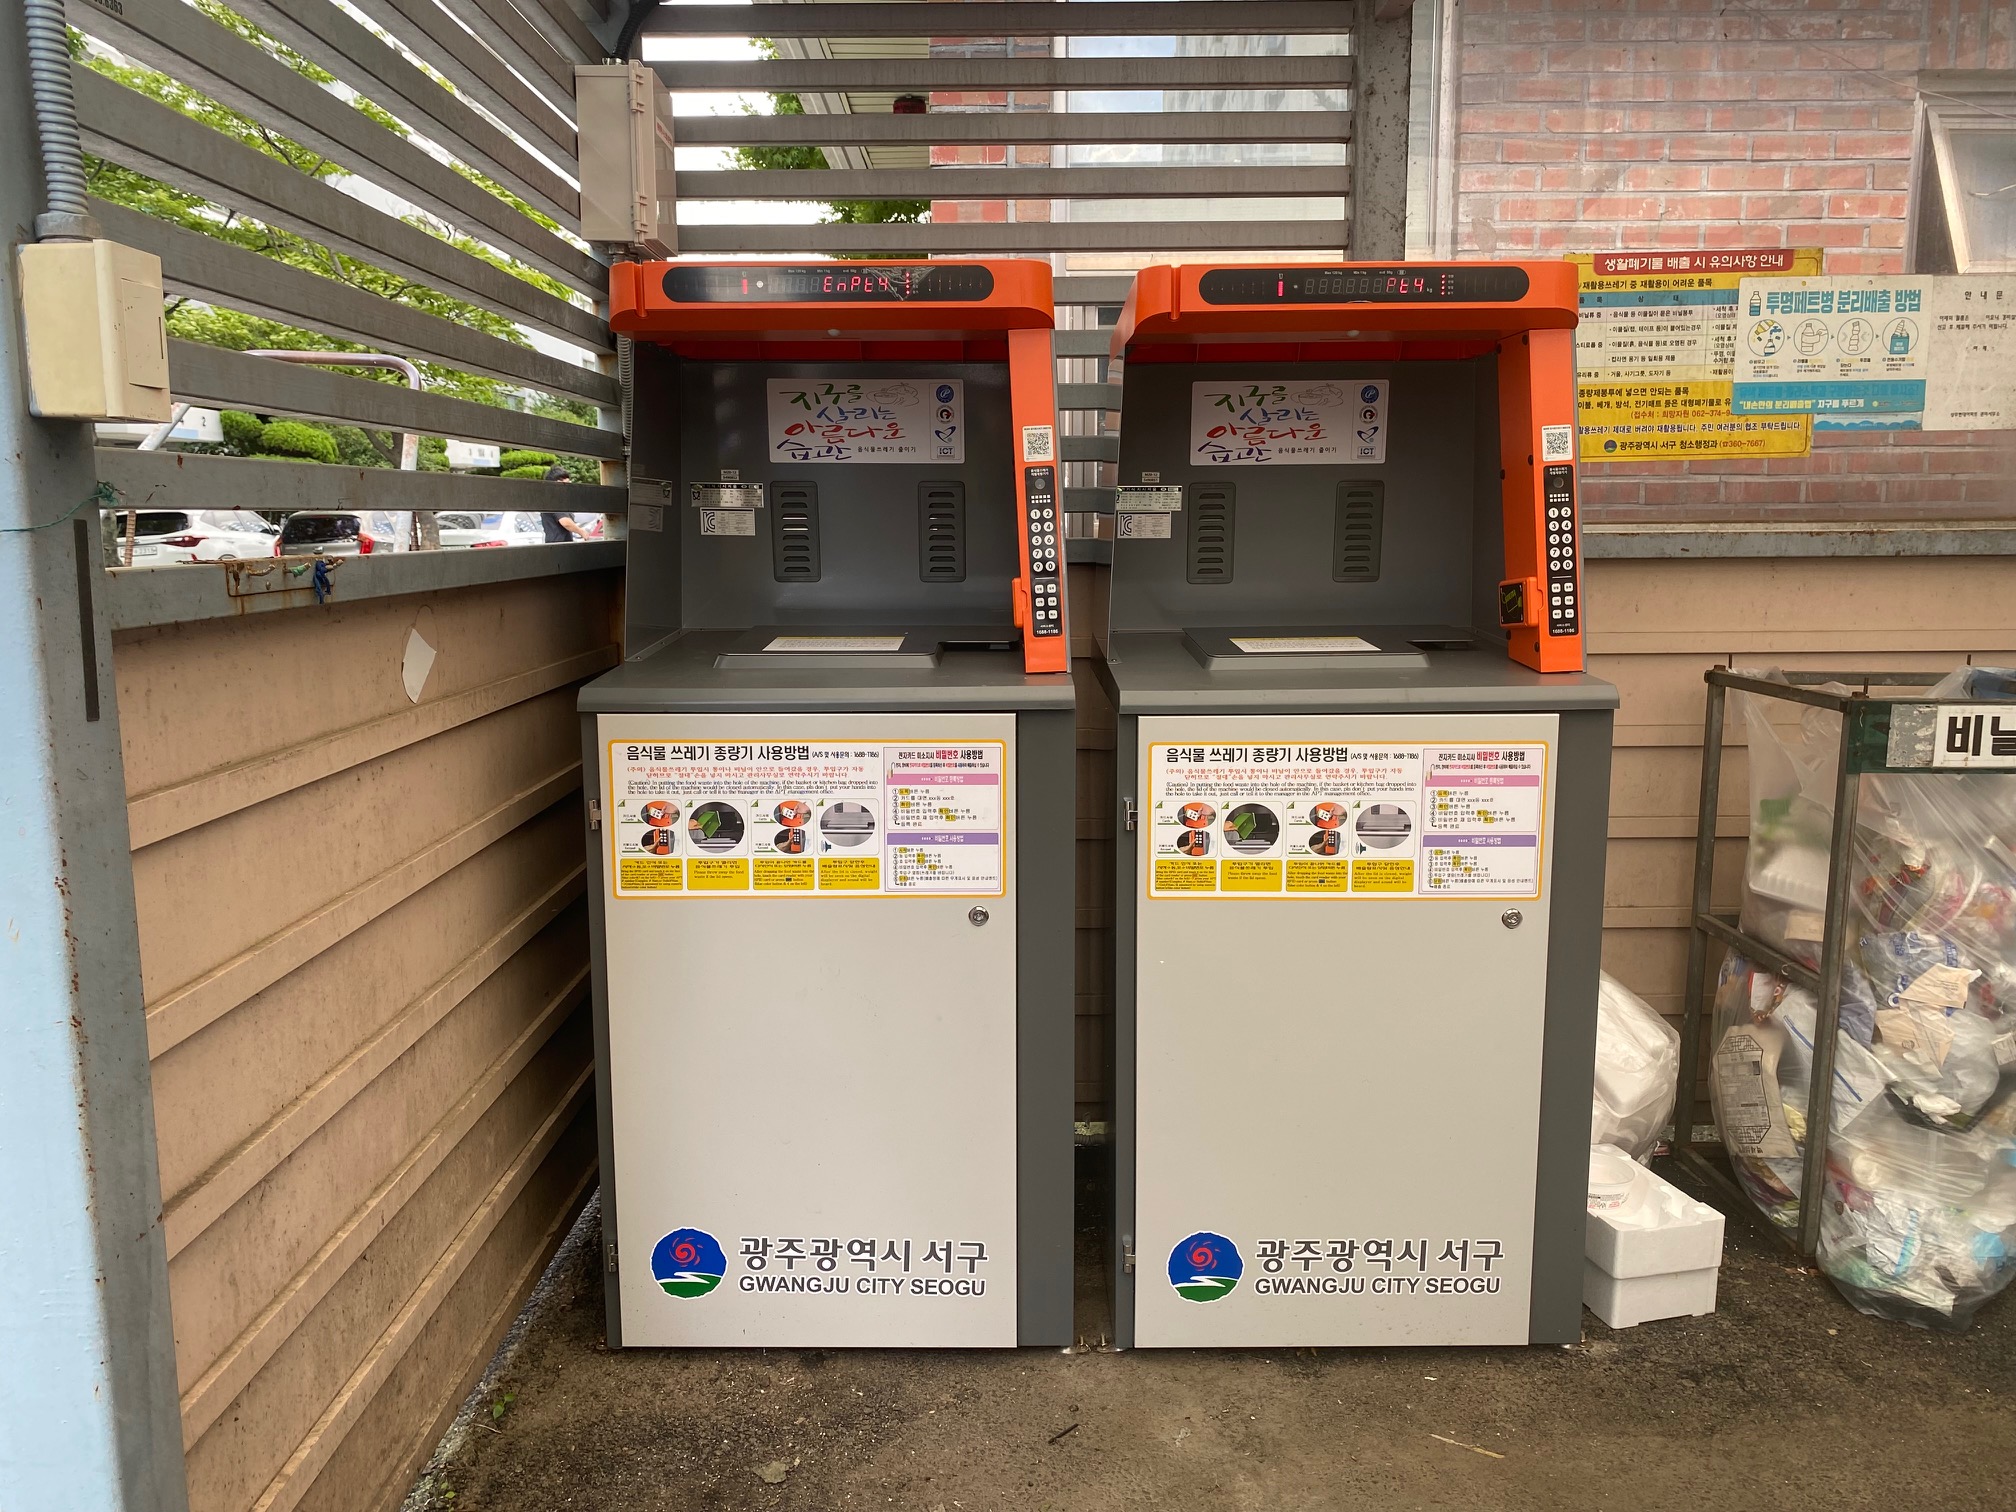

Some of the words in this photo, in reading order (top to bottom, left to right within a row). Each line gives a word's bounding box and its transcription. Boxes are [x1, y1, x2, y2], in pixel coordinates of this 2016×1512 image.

[1605, 257, 1663, 271] 생활폐기물
[1667, 257, 1690, 270] 배출
[1694, 256, 1706, 268] 시
[1709, 255, 1758, 268] 유의사항
[1760, 254, 1783, 267] 안내
[1583, 281, 1627, 289] 재활용쓰레기
[1630, 280, 1637, 288] 중
[1640, 279, 1669, 288] 재활용이
[1673, 279, 1694, 288] 어려운
[1698, 278, 1712, 287] 품목
[1766, 290, 1834, 314] 투명페트병
[1837, 289, 1891, 313] 분리배출
[1894, 289, 1922, 312] 방법
[779, 383, 864, 411] 지구를
[1204, 385, 1288, 413] 지구를
[1626, 388, 1647, 396] 넣으면
[1650, 387, 1671, 396] 안되는
[1675, 387, 1689, 395] 품목
[1578, 401, 1593, 409] 이불,
[1597, 401, 1612, 409] 베개,
[1616, 400, 1632, 408] 방석,
[816, 406, 897, 424] 살리는
[1240, 407, 1319, 426] 살리는
[1631, 411, 1654, 419] (접수처
[784, 420, 906, 444] 아름다운
[1206, 423, 1328, 446] 아름다운
[1635, 425, 1654, 433] 버려야
[1701, 423, 1713, 431] 주민
[1717, 423, 1742, 431] 여러분의
[1745, 423, 1757, 431] 협조
[1761, 422, 1801, 430] 부탁드립니다.
[898, 445, 916, 453] 줄이기
[939, 447, 953, 455] ICT
[1360, 447, 1374, 455] ICT
[1620, 441, 1658, 450] 광주광역시
[1662, 441, 1676, 450] 서구
[1680, 440, 1717, 449] 청소행정과
[626, 745, 666, 761] 음식물
[671, 746, 710, 761] 쓰레기
[714, 746, 752, 761] 종량기
[758, 746, 809, 761] 사용방법
[899, 751, 916, 759] 전자카드
[936, 750, 959, 759] 비밀번호
[960, 749, 983, 759] 사용방법
[1166, 747, 1205, 763] 음식물
[1209, 747, 1248, 762] 쓰레기
[1252, 747, 1291, 763] 종량기
[1296, 747, 1348, 762] 사용방법
[1439, 753, 1456, 761] 전자카드
[1476, 751, 1500, 761] 비밀번호
[1501, 751, 1525, 761] 사용방법
[740, 1237, 911, 1273] 광주광역시
[922, 1240, 988, 1274] 서구
[1256, 1240, 1426, 1273] 광주광역시
[1439, 1240, 1504, 1272] 서구
[739, 1276, 850, 1294] GWANGJU
[857, 1277, 904, 1294] CITY
[911, 1279, 985, 1296] SEOGU
[1255, 1278, 1364, 1295] GWANGJU
[1372, 1277, 1421, 1294] CITY
[1425, 1277, 1500, 1294] SEOGU
